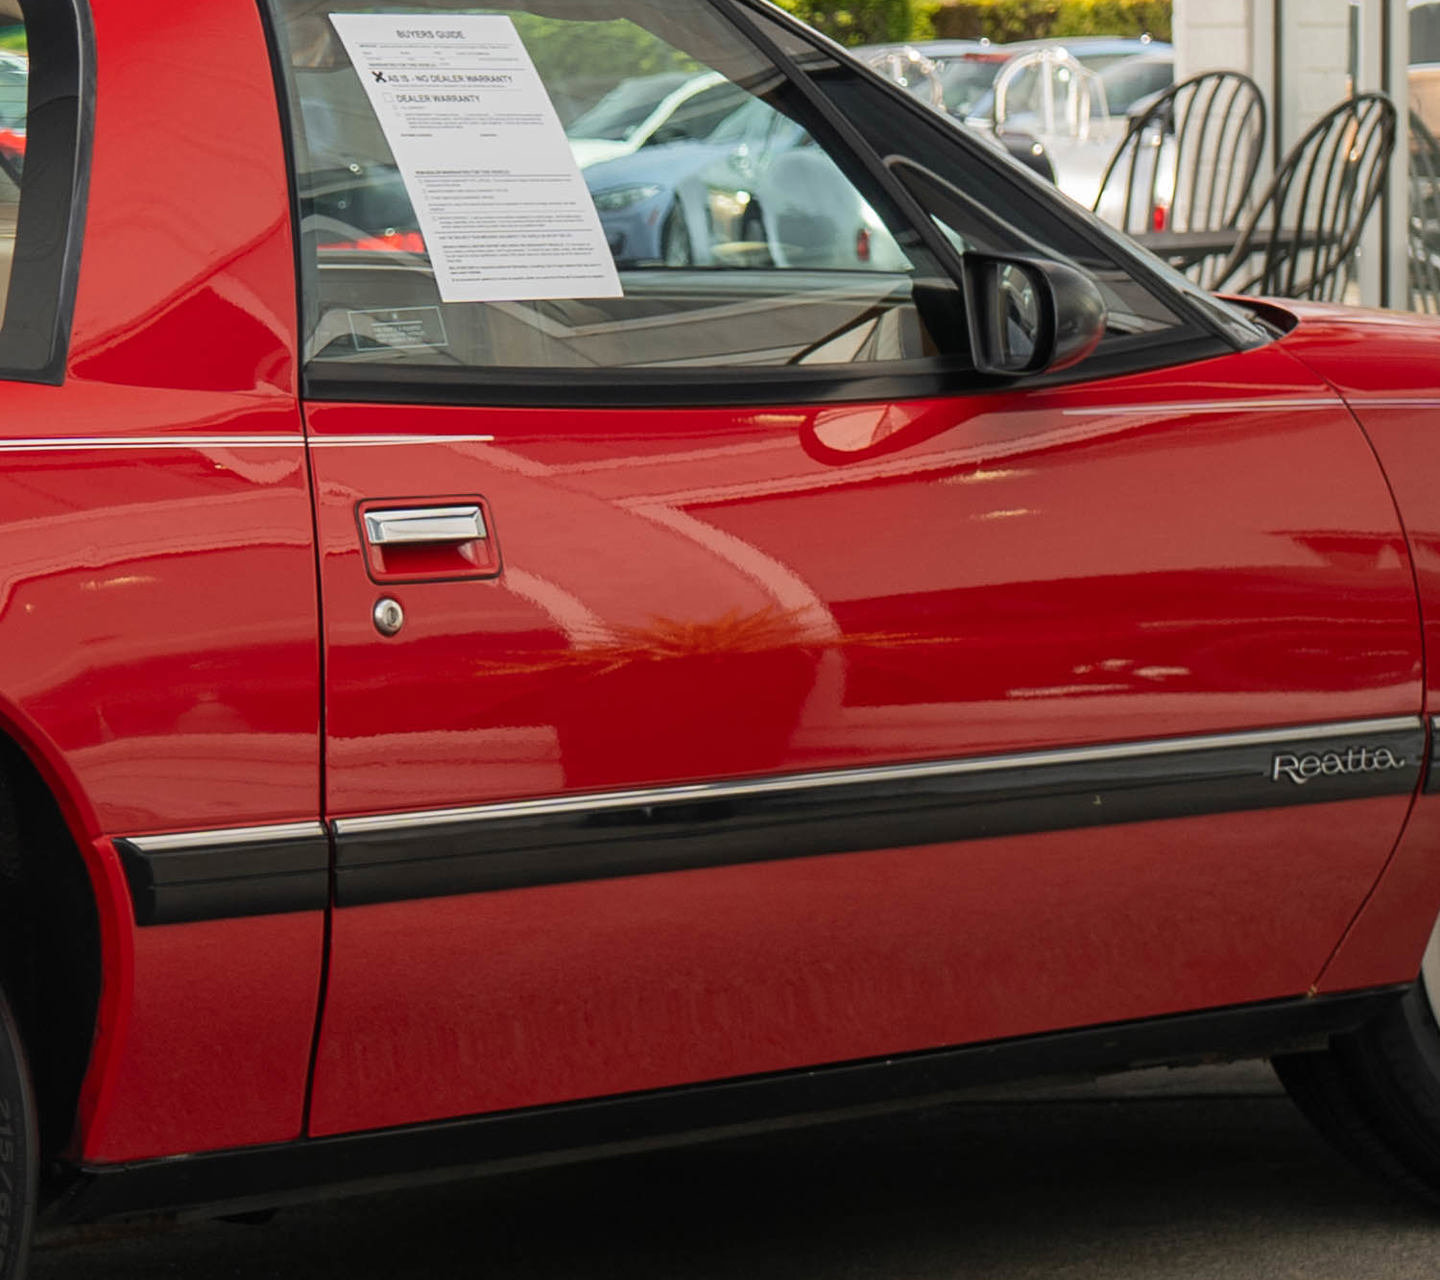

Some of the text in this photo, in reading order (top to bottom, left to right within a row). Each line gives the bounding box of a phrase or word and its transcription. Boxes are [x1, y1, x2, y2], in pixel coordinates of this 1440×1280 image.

[396, 30, 466, 39] BUYERS GUIDE
[396, 95, 481, 103] DEALER WARRANTY
[1272, 746, 1406, 785] Reatta
